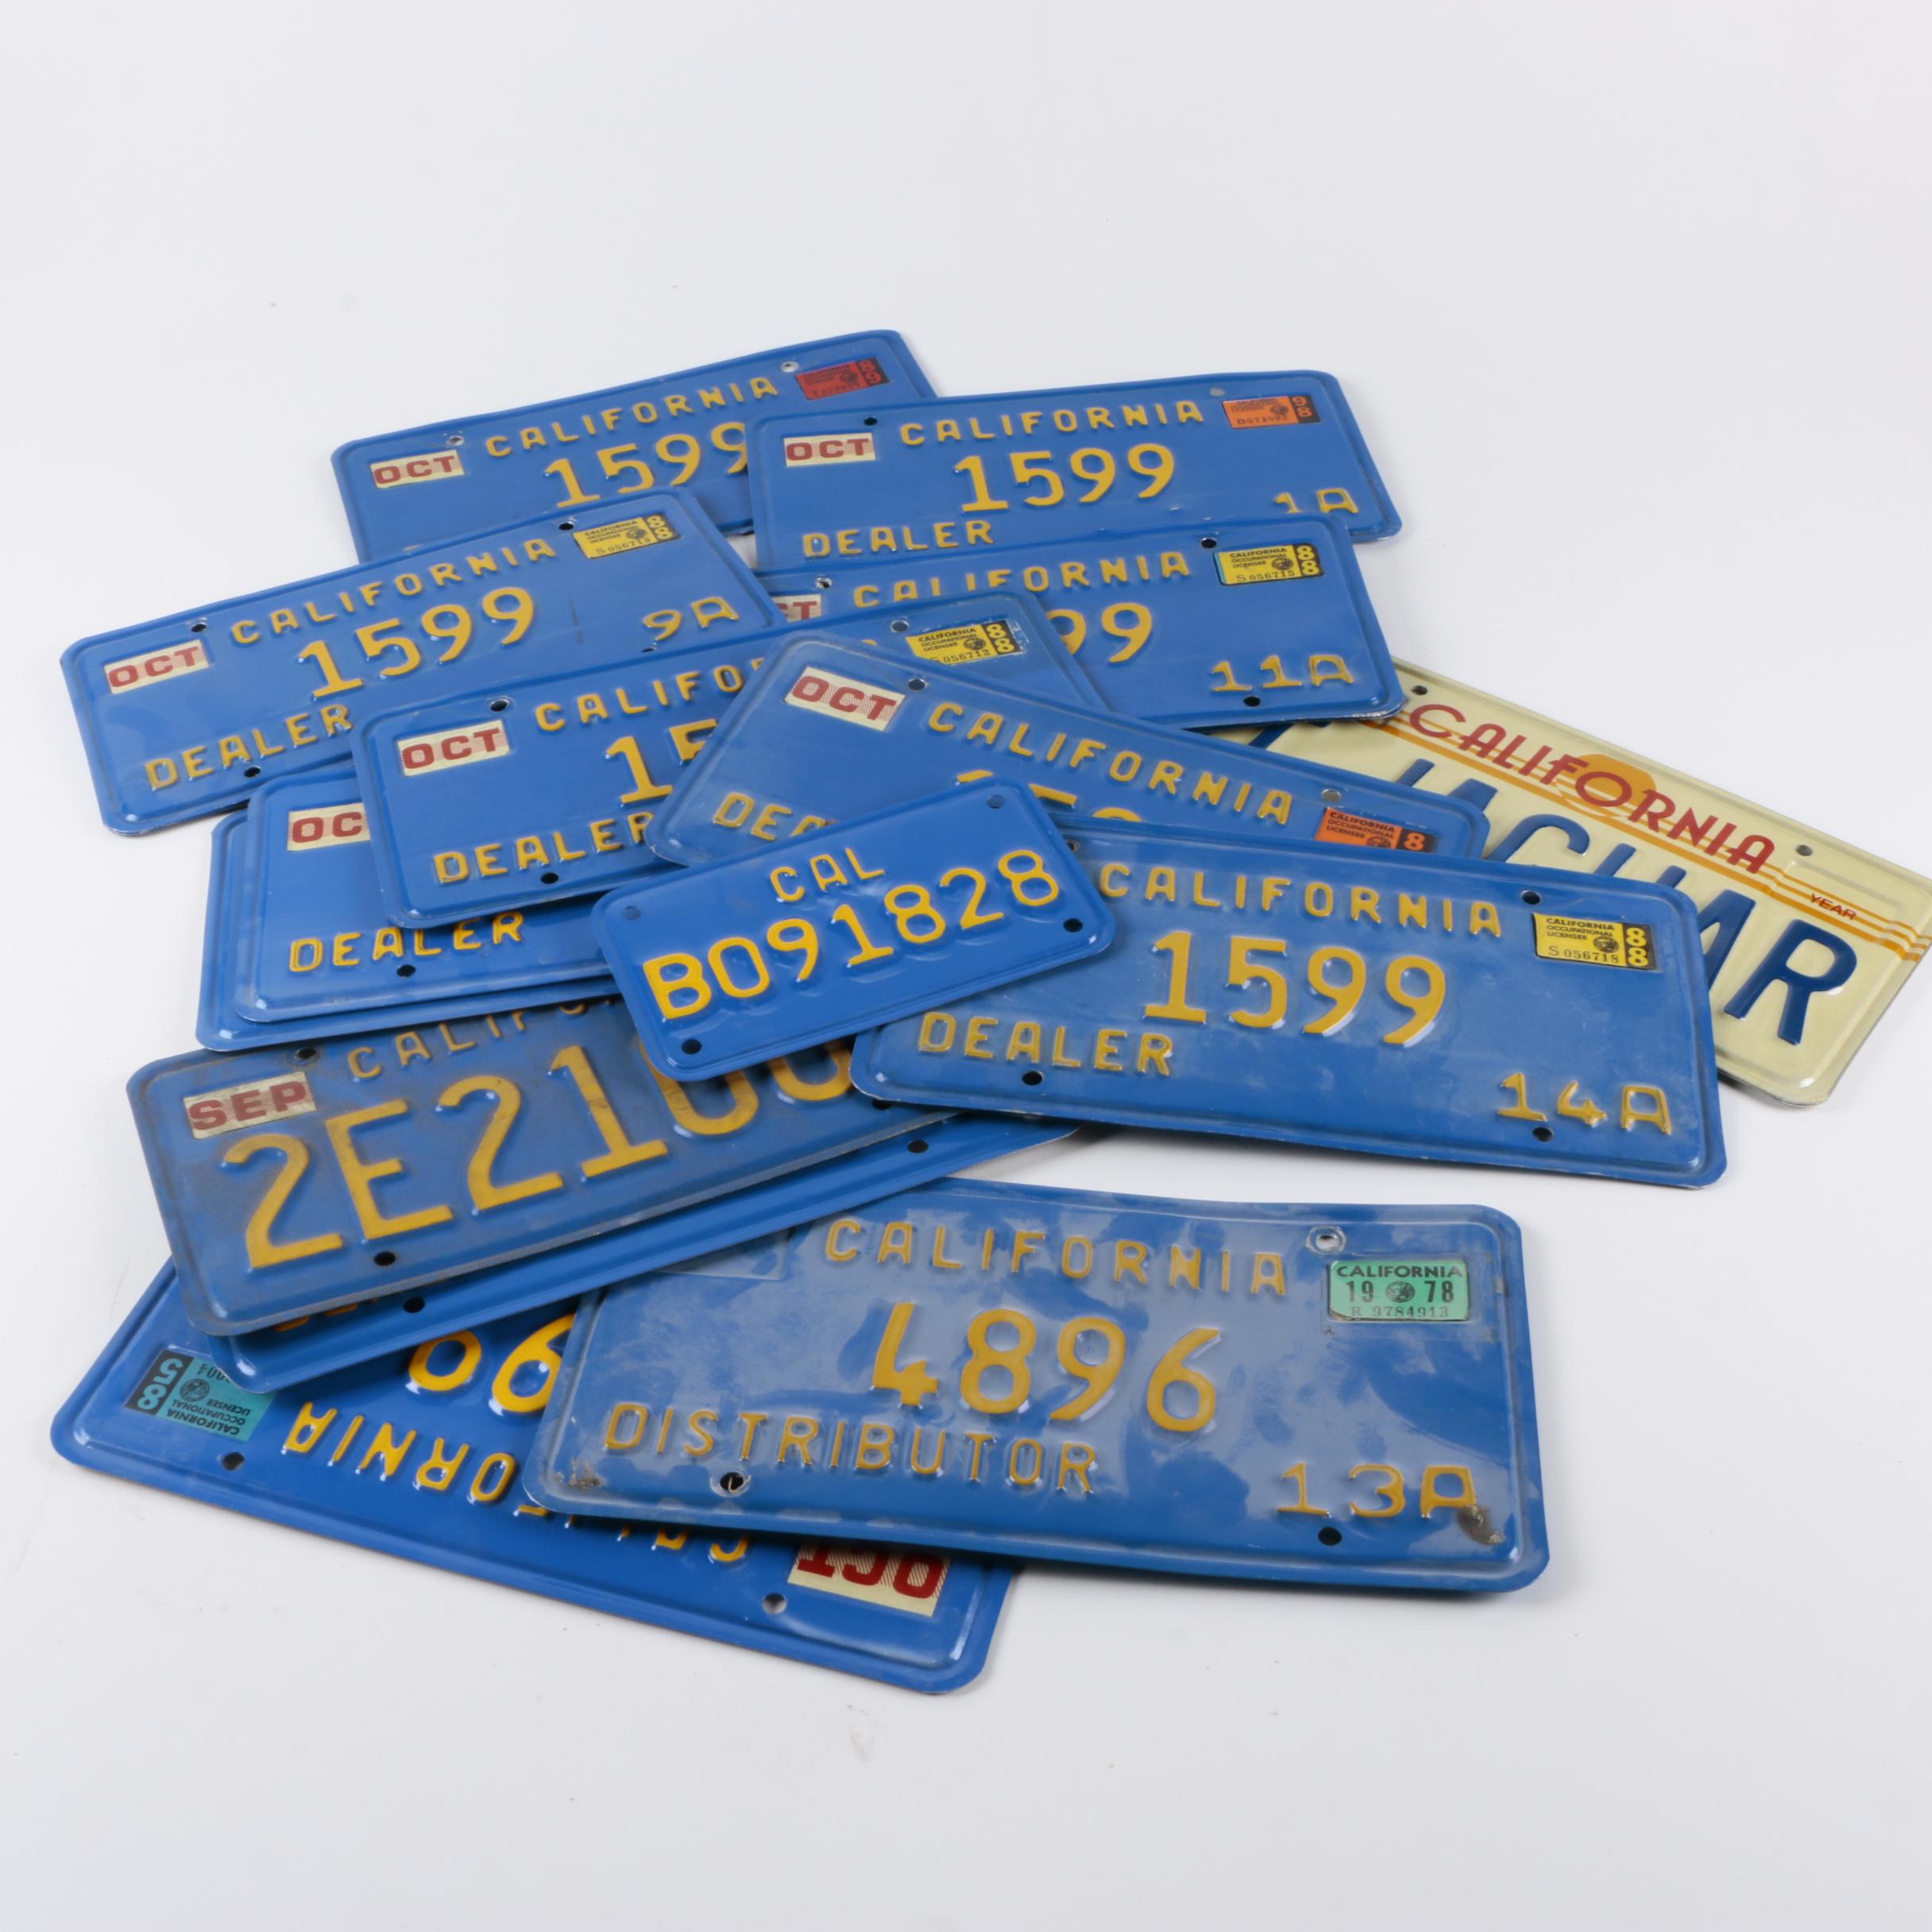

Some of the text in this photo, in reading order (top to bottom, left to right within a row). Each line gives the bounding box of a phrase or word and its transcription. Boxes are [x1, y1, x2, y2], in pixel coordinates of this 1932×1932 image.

[486, 377, 778, 457] CALIFORNIA
[900, 400, 1204, 446] CALIFORNIA
[374, 455, 455, 485] OCT
[546, 422, 747, 508] 1599
[786, 439, 870, 462] OCT
[956, 443, 1175, 512] 1599
[1275, 488, 1358, 513] 1A
[803, 520, 993, 556] DEALER
[1230, 547, 1288, 558] CALIFORNIA
[1296, 545, 1320, 575] 88
[232, 539, 556, 643] CALIFORNIA
[644, 597, 739, 640] 9A
[918, 628, 976, 642] CALIFORNIA
[986, 624, 1014, 652] 88
[299, 587, 534, 697] 1599
[108, 645, 199, 688] OCT
[1213, 655, 1354, 692] 11A
[791, 674, 899, 721] OCT
[145, 705, 353, 789] DEALER
[402, 728, 500, 770] OCT
[929, 703, 1293, 825] CALIFORNIA
[1409, 704, 1776, 876] CALIFORNIA
[1326, 825, 1365, 838] LICENSEE
[1328, 819, 1393, 839] OCCUPATIONAL
[1330, 812, 1395, 833] CALIFORNIA
[770, 847, 886, 902] CAL
[1099, 863, 1501, 937] CALIFORNIA
[1811, 893, 1857, 920] YEAR
[289, 914, 524, 972] DEALER
[1546, 918, 1614, 930] CALIFORNIA
[1547, 925, 1614, 937] OCCUPATIONAL
[1547, 931, 1587, 940] LICENSEE
[1626, 927, 1648, 967] 88
[1145, 930, 1447, 1045] 1599
[918, 1011, 1173, 1075] DEALER
[189, 1082, 307, 1129] SEP
[1499, 1072, 1673, 1134] 14A
[825, 1219, 1286, 1296] CALIFORNIA
[1336, 1265, 1463, 1278] CALIFORNIA
[1346, 1280, 1454, 1303] 19 78
[1373, 1306, 1448, 1317] 9784913
[137, 1358, 183, 1410] 85
[871, 1301, 1221, 1433] 4896
[167, 1408, 241, 1435] CALIFORNIA
[172, 1399, 245, 1425] OCCUPATIONAL
[206, 1398, 251, 1416] LICENSEE
[604, 1403, 1097, 1492] DISTRIBUTOR
[1277, 1462, 1476, 1518] 13A
